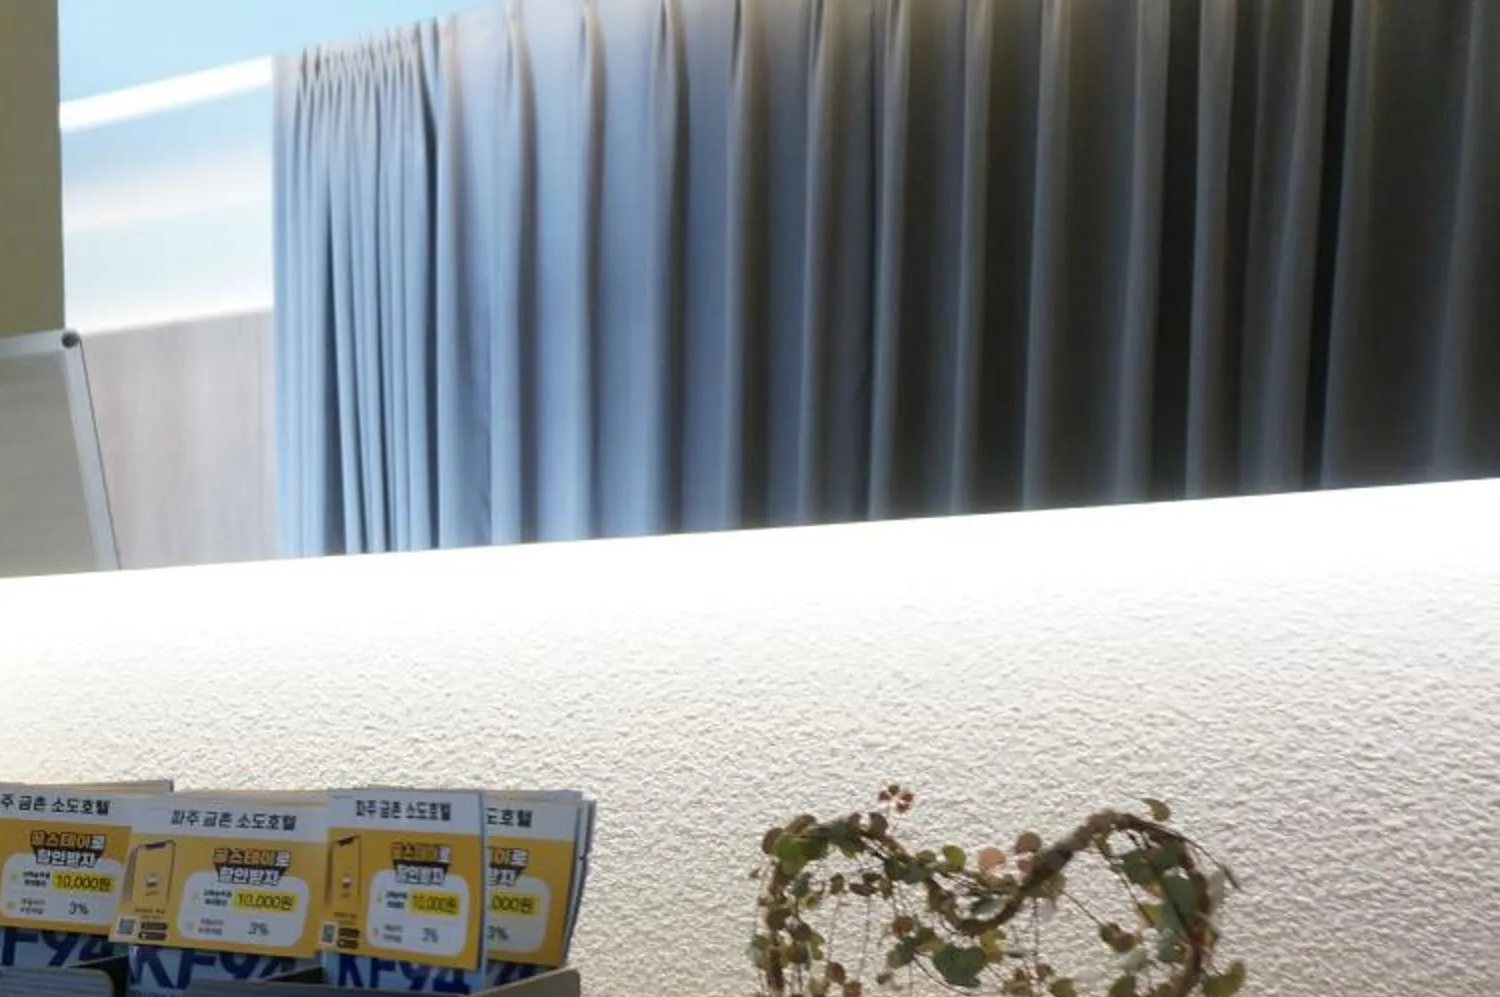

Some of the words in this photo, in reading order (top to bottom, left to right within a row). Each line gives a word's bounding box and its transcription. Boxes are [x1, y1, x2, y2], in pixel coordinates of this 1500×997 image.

[51, 796, 111, 816] 소도호텔
[171, 809, 201, 828] 파주
[235, 812, 297, 832] 소도호텔
